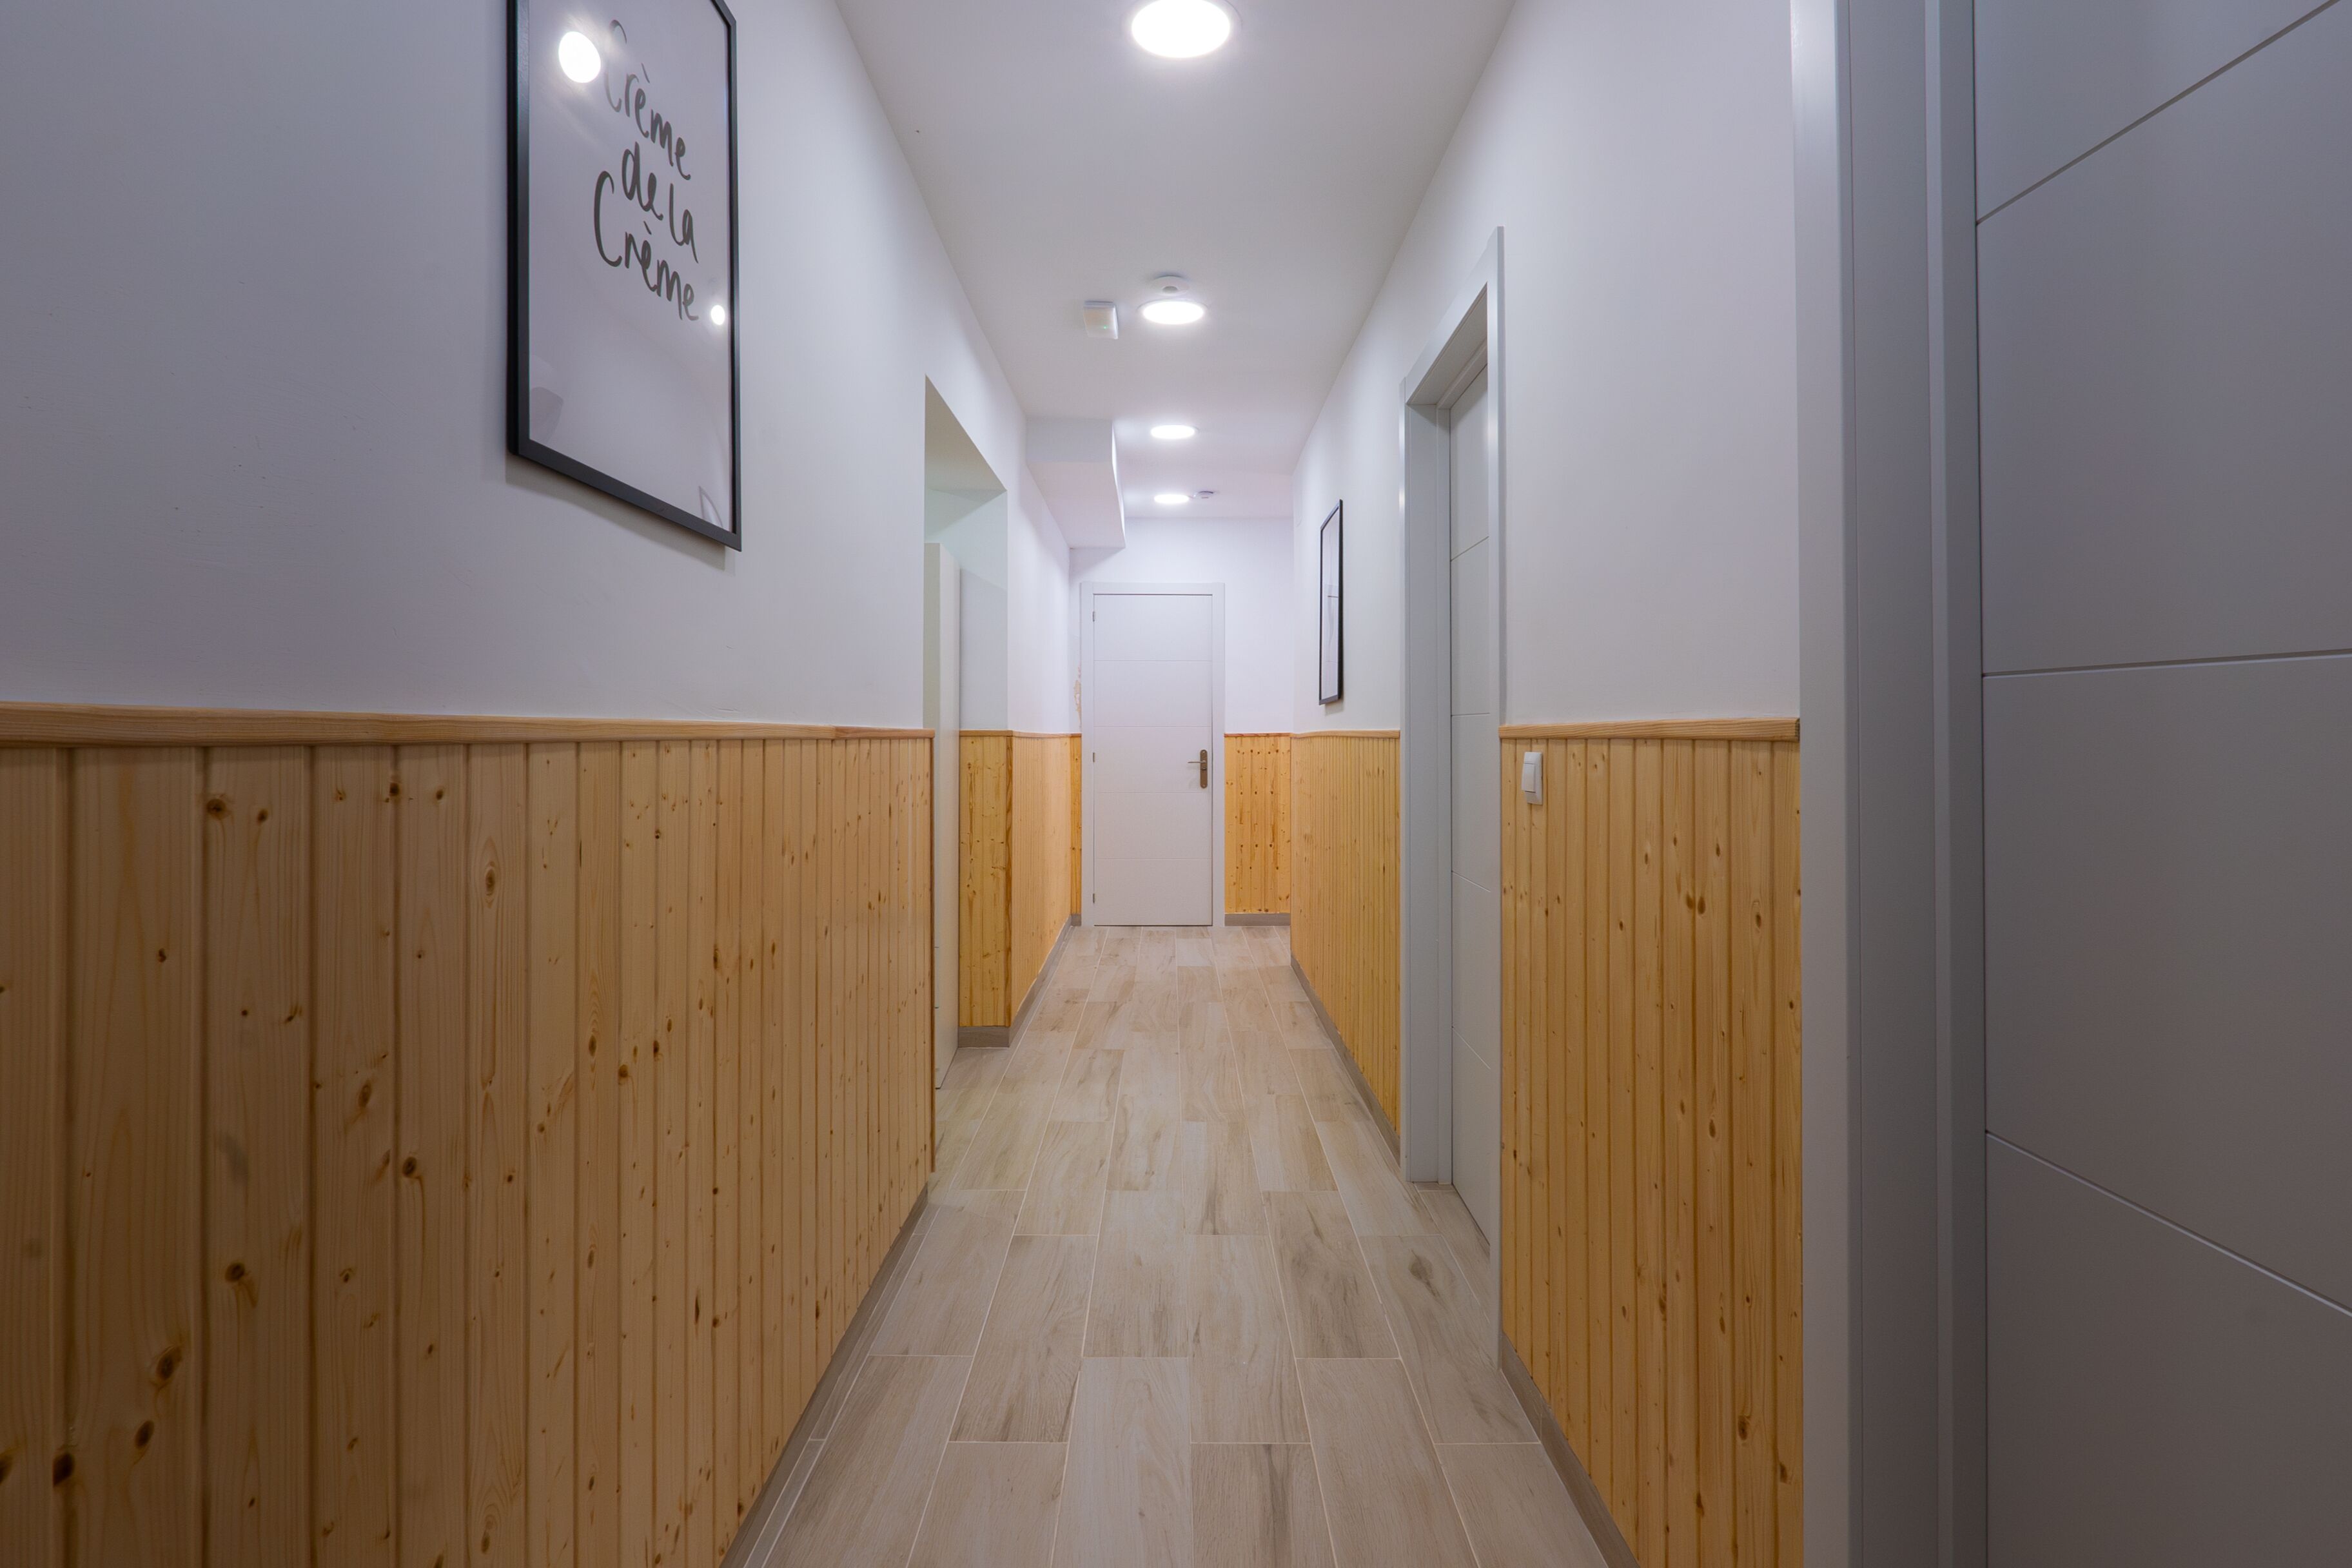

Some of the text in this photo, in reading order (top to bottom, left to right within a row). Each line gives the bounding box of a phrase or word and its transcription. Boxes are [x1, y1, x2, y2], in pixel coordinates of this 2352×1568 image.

[604, 19, 691, 181] Crème
[593, 170, 699, 321] Crème
[622, 141, 698, 264] de la
